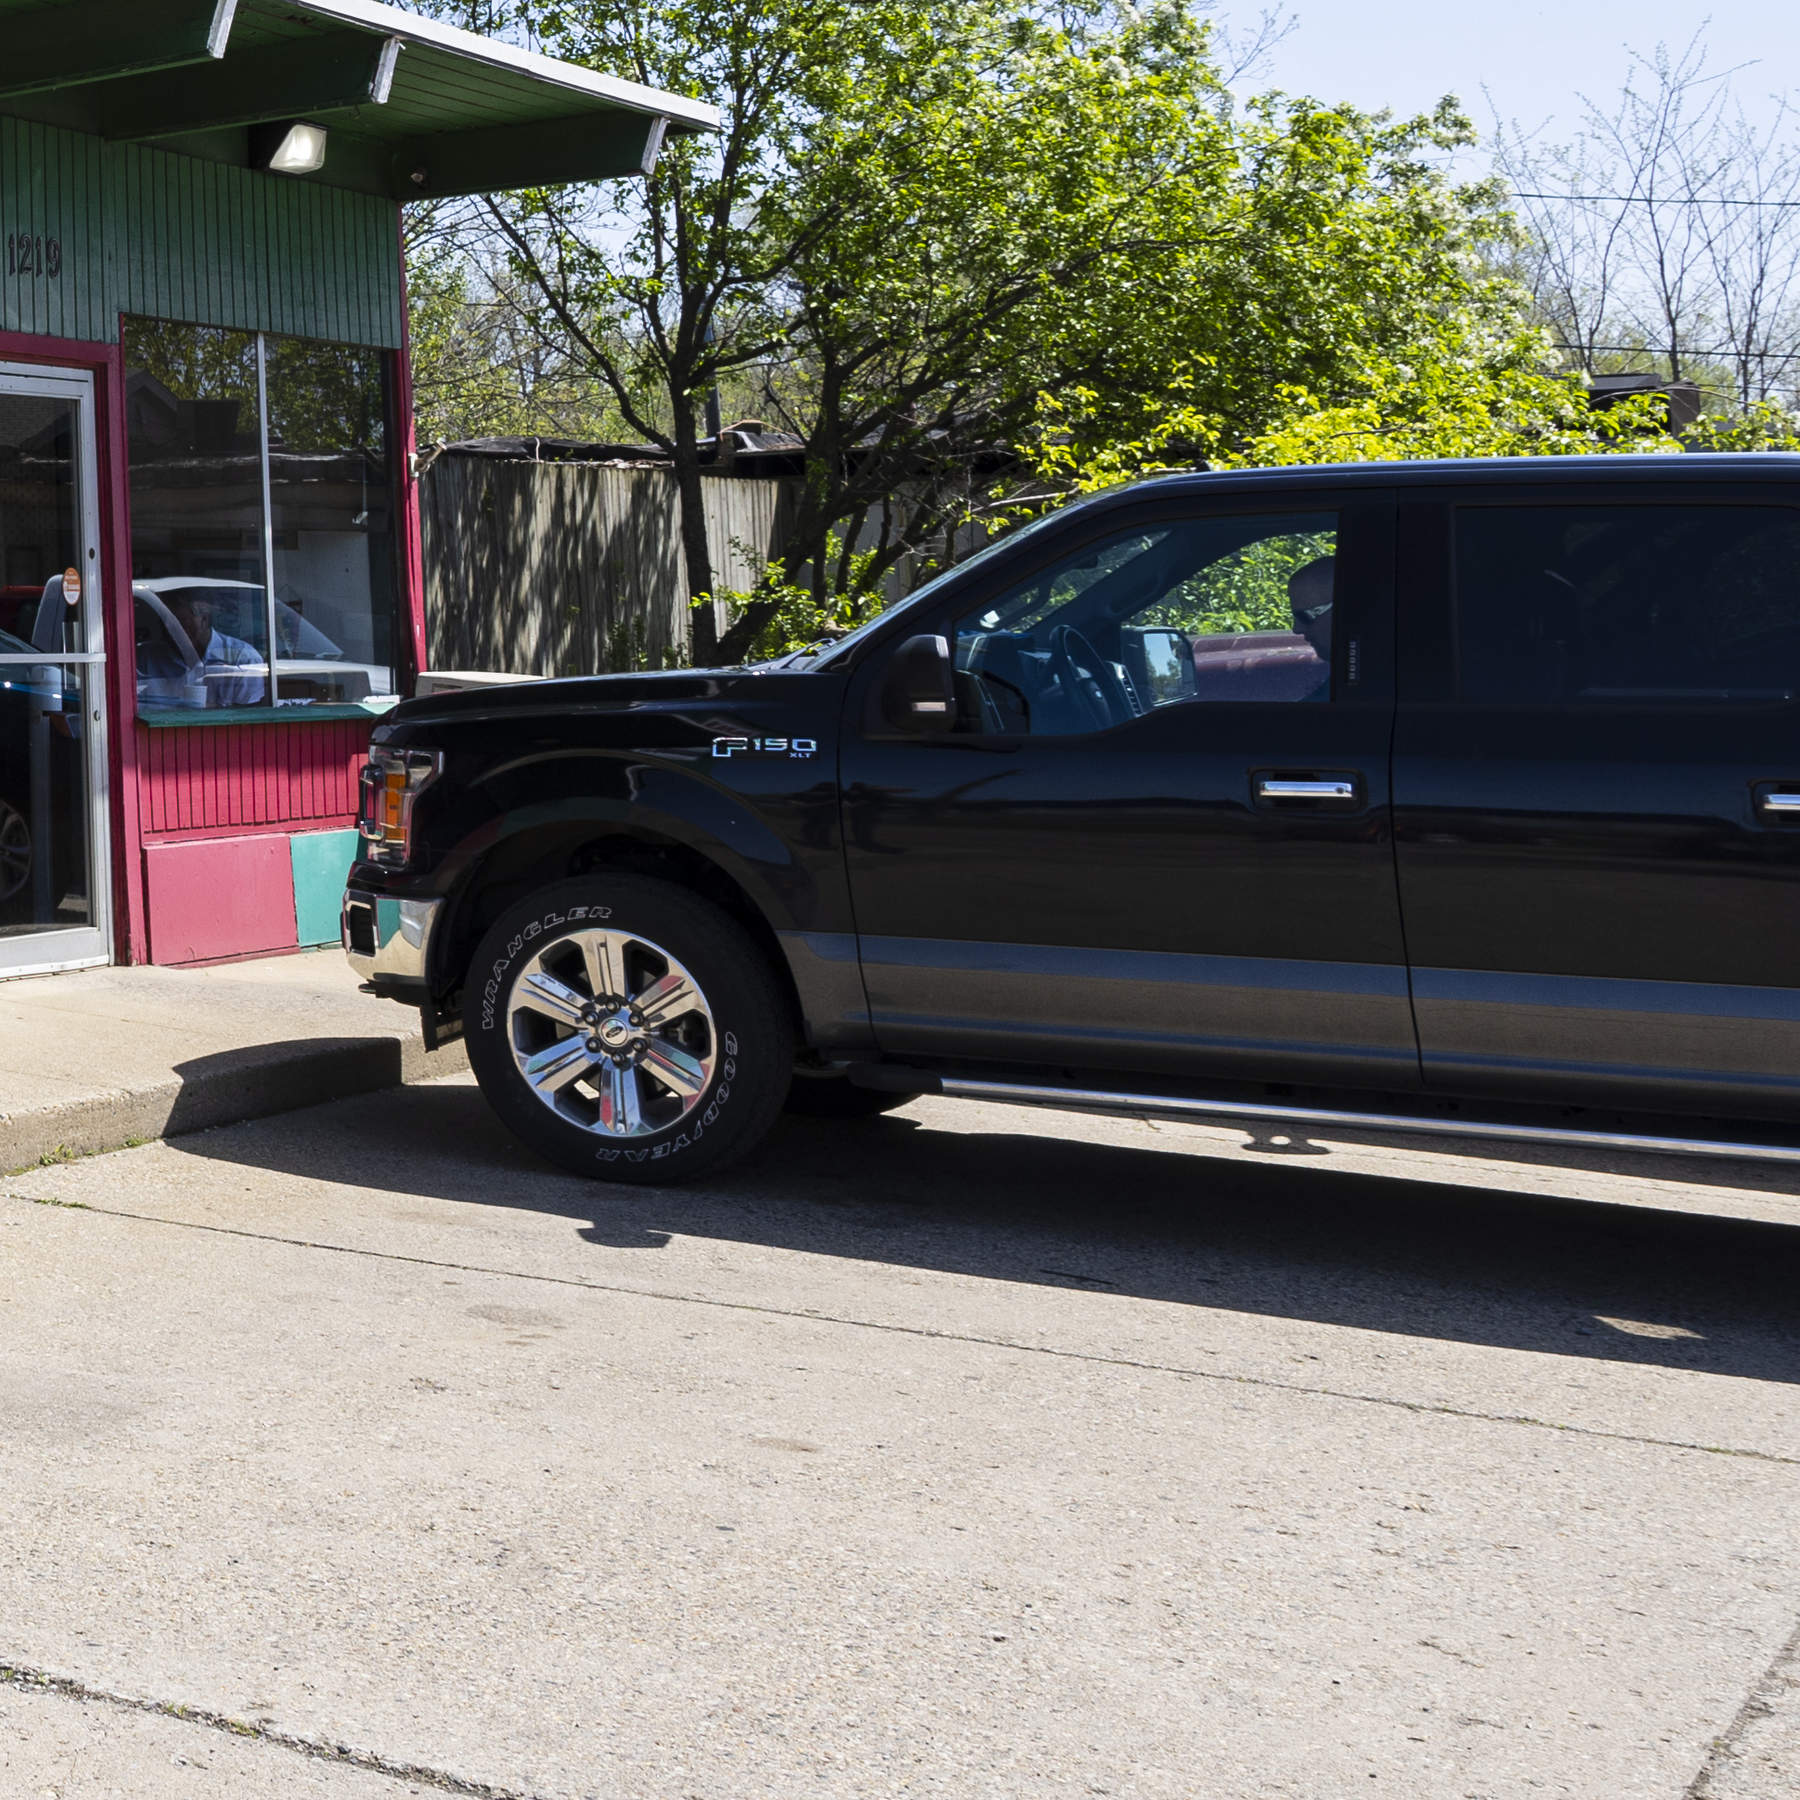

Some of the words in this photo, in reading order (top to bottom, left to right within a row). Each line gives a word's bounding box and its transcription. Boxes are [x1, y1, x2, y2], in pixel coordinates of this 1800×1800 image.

[8, 232, 61, 280] 1219
[481, 906, 612, 1030] WRANGLER
[596, 1031, 738, 1161] GOODYEAR
